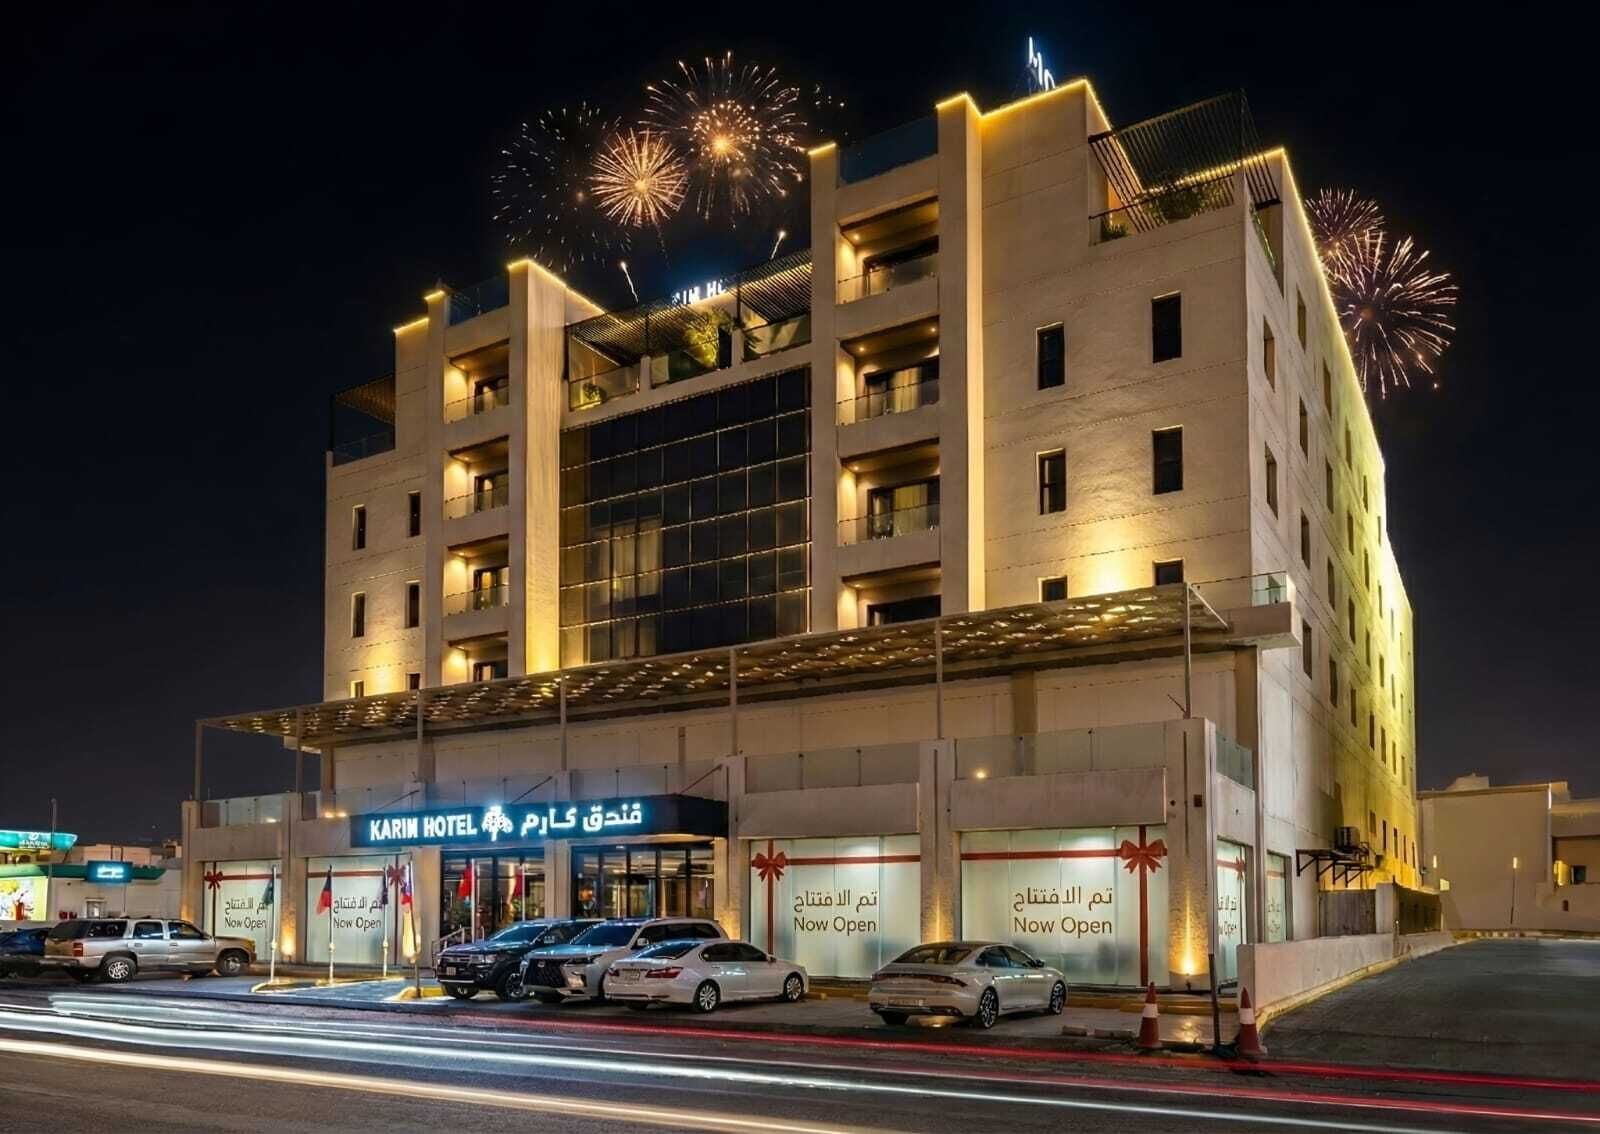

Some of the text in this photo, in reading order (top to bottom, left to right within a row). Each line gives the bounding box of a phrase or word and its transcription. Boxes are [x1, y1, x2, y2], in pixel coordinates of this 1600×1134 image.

[370, 814, 478, 841] KARIM HOTEL
[520, 807, 577, 837] كارم
[793, 889, 878, 913] تم الافتتاح
[1013, 886, 1113, 913] تم الافتتاح
[225, 916, 267, 931] Now Open
[333, 916, 382, 933] Now Open
[793, 915, 877, 937] Now Open
[1014, 916, 1113, 939] Now Open
